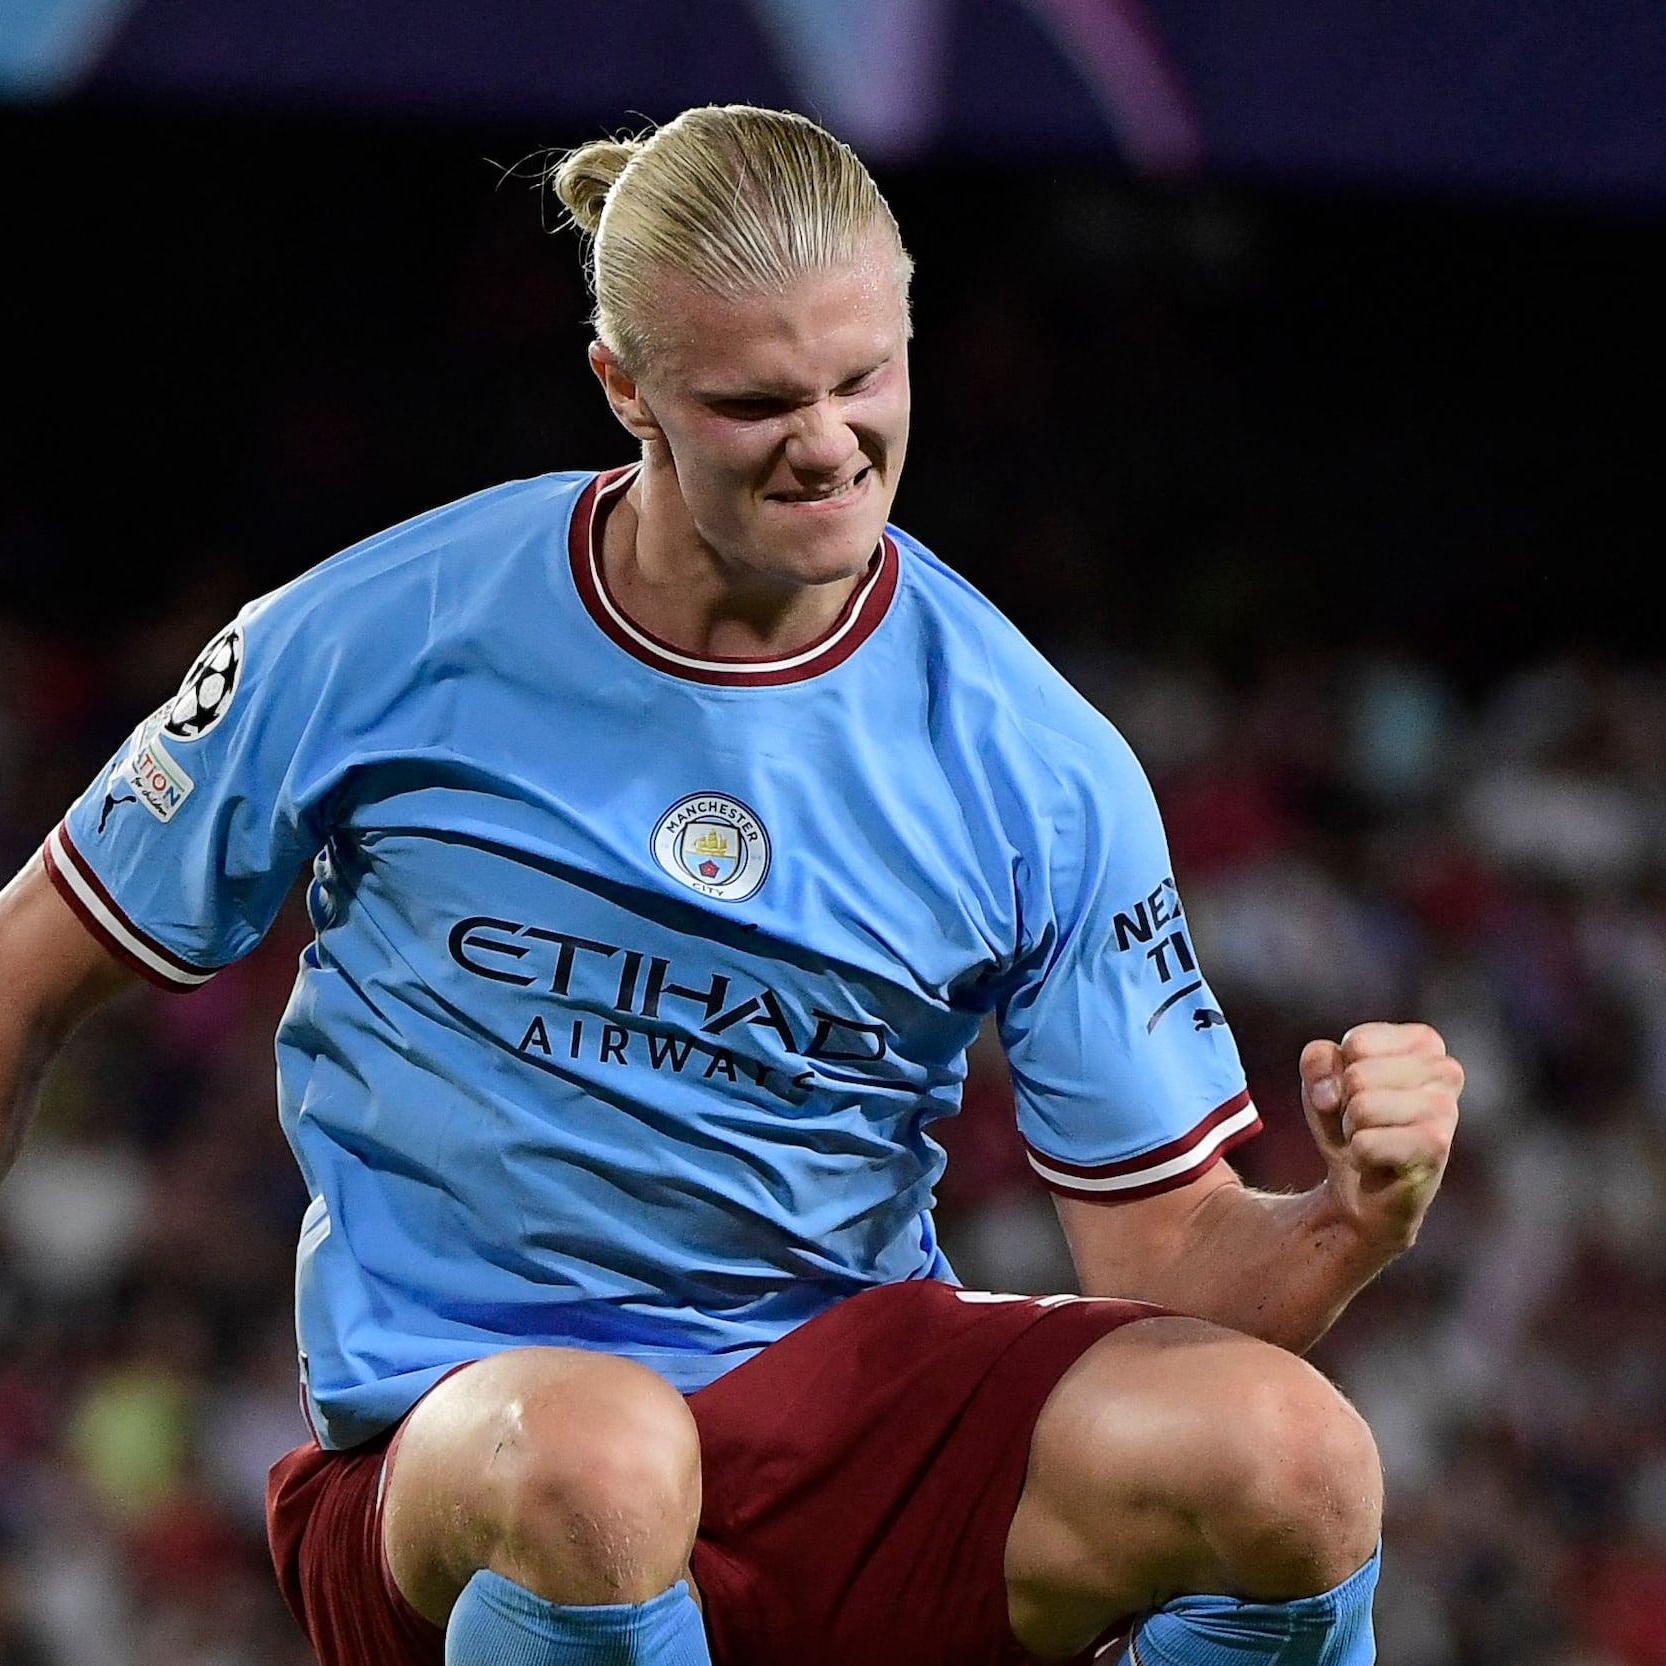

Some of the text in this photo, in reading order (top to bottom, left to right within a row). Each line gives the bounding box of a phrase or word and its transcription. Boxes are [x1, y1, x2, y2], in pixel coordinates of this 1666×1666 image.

[666, 801, 759, 843] MANCHESTER
[692, 883, 725, 897] CITY
[448, 915, 887, 1062] ETIHAD
